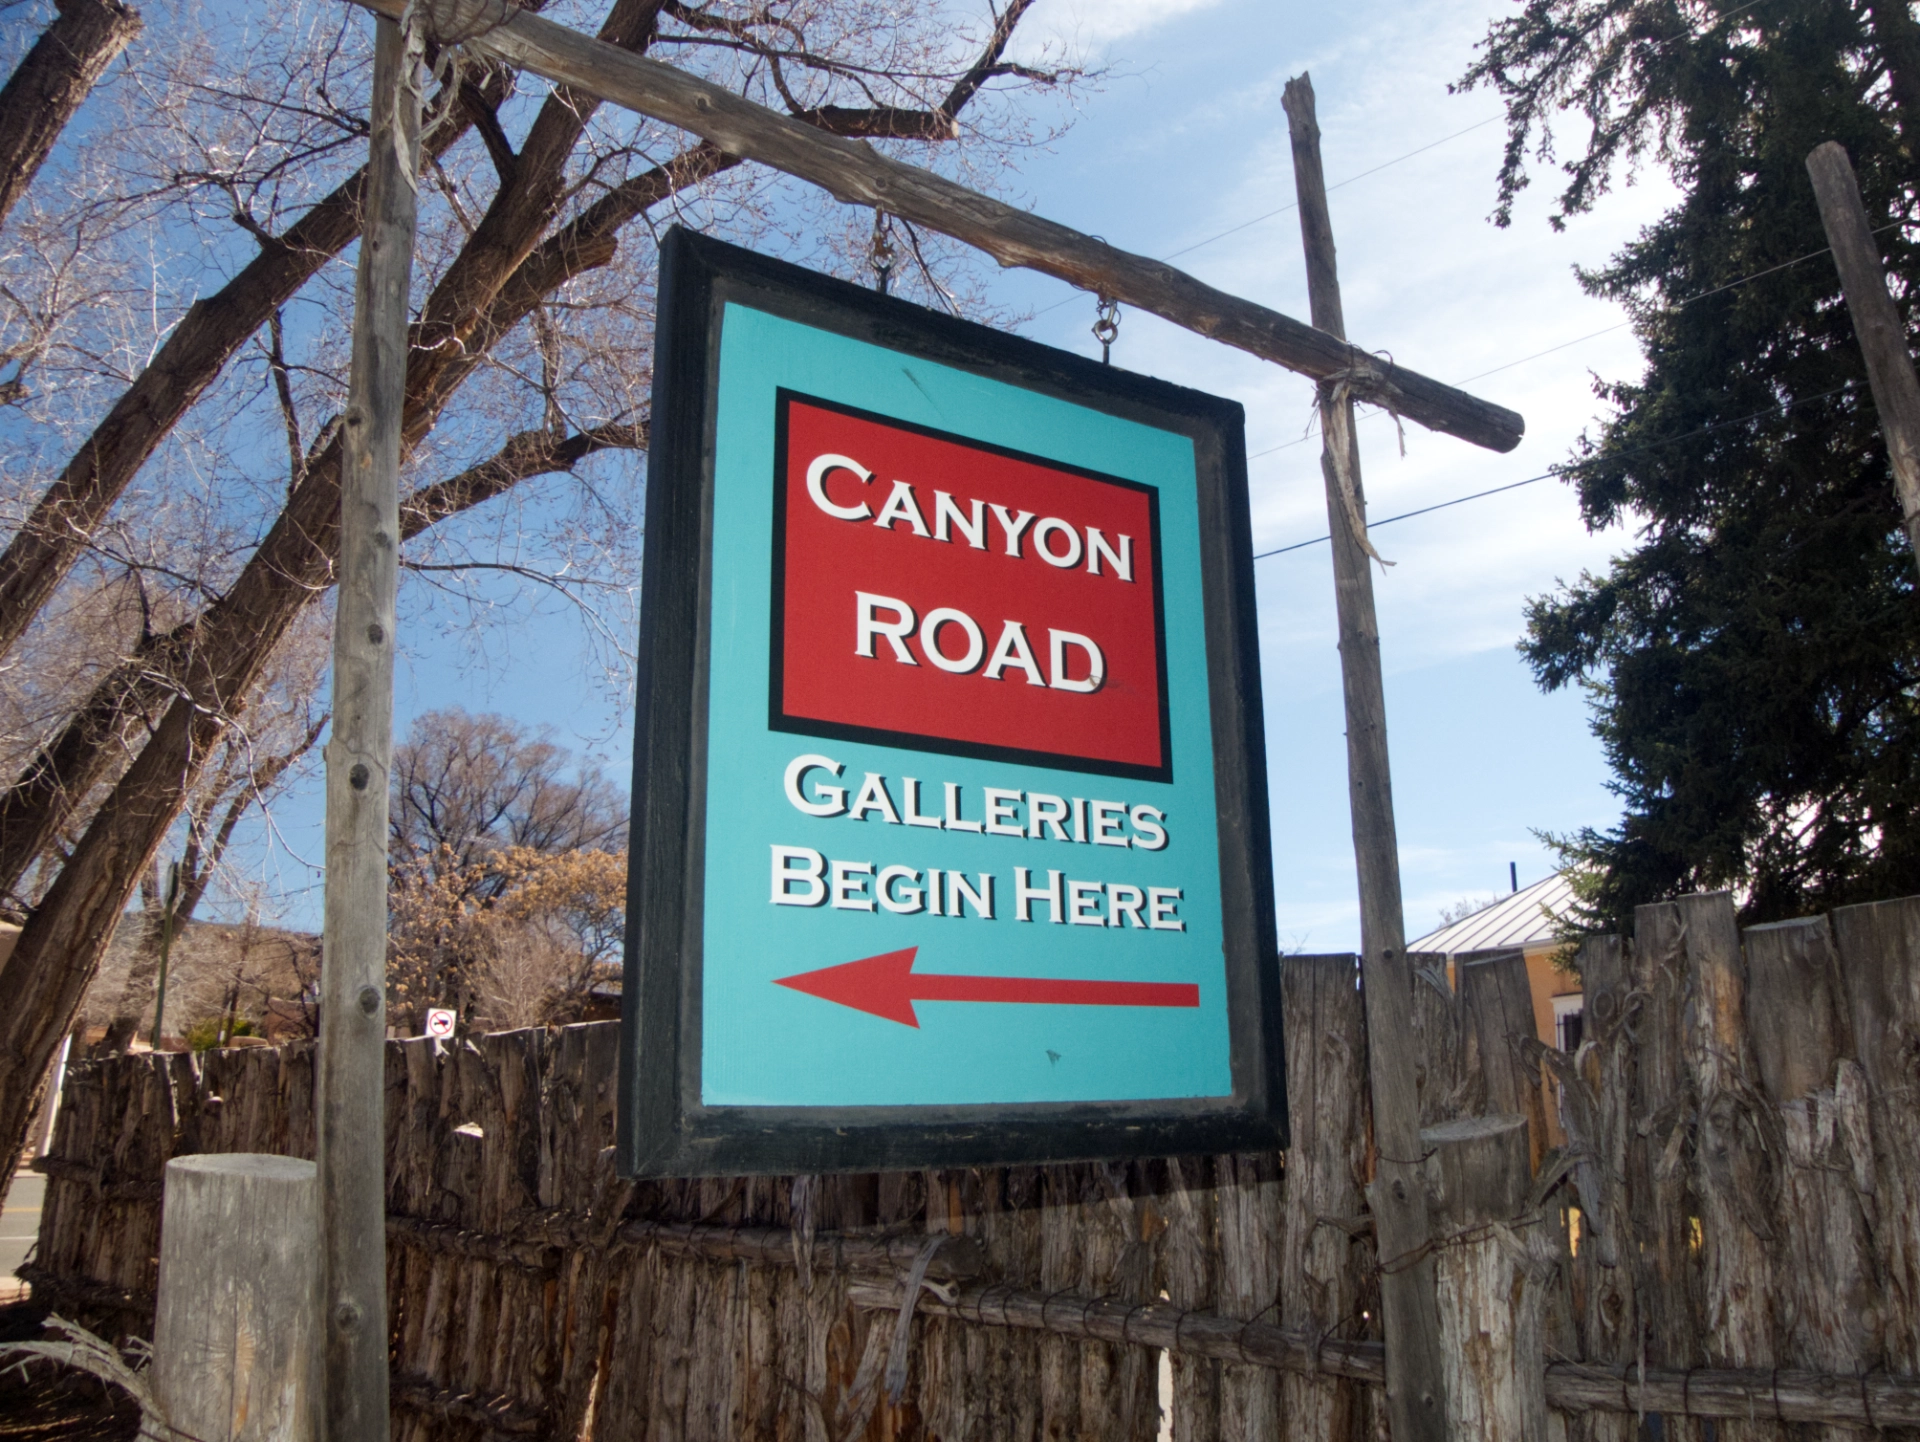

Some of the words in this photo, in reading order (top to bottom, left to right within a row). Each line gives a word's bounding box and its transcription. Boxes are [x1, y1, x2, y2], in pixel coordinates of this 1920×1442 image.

[806, 453, 1135, 582] CANYON
[855, 590, 1106, 693] ROAD
[783, 754, 1168, 851] GALLERIES
[769, 844, 997, 920] BEGIN
[1013, 866, 1187, 932] HERE
